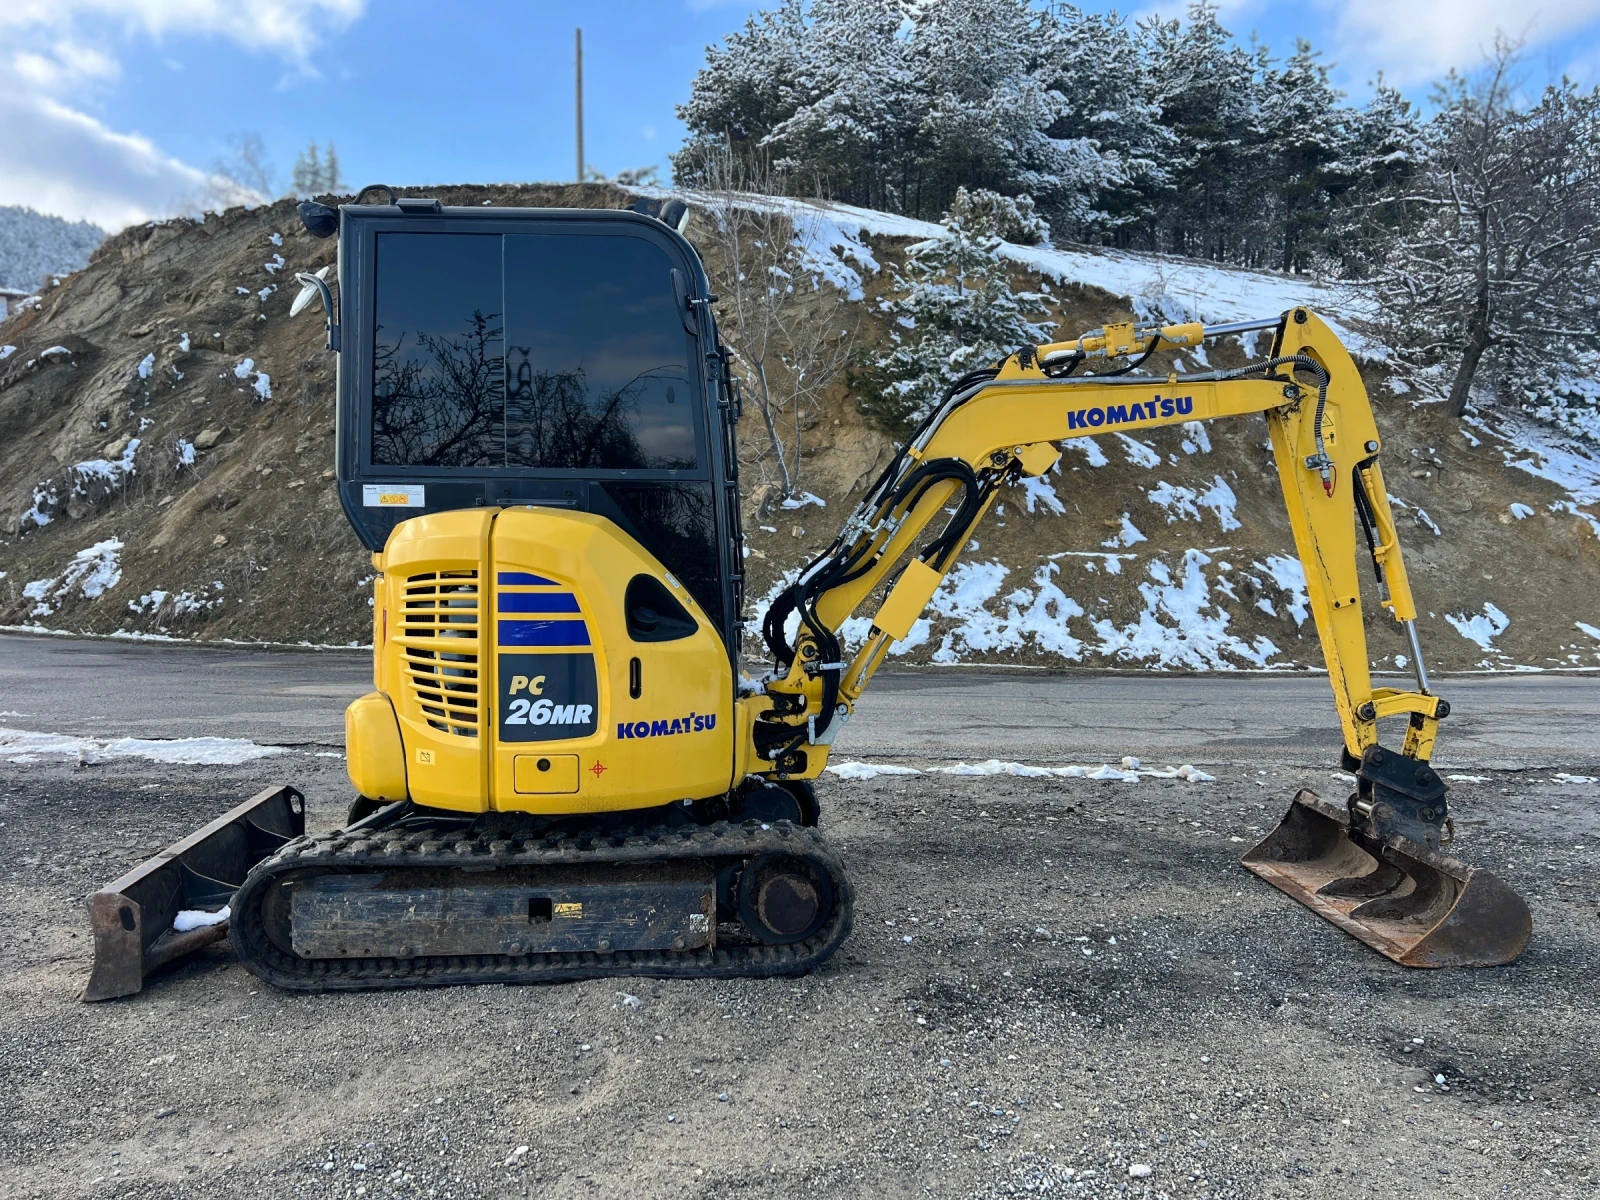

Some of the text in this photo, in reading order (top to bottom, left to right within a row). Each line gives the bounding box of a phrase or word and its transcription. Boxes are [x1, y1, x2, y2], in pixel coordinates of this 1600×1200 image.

[1067, 395, 1193, 430] KOMATSU
[508, 675, 546, 695] PC
[504, 698, 593, 725] 26MR
[617, 712, 716, 739] KOMATSU
